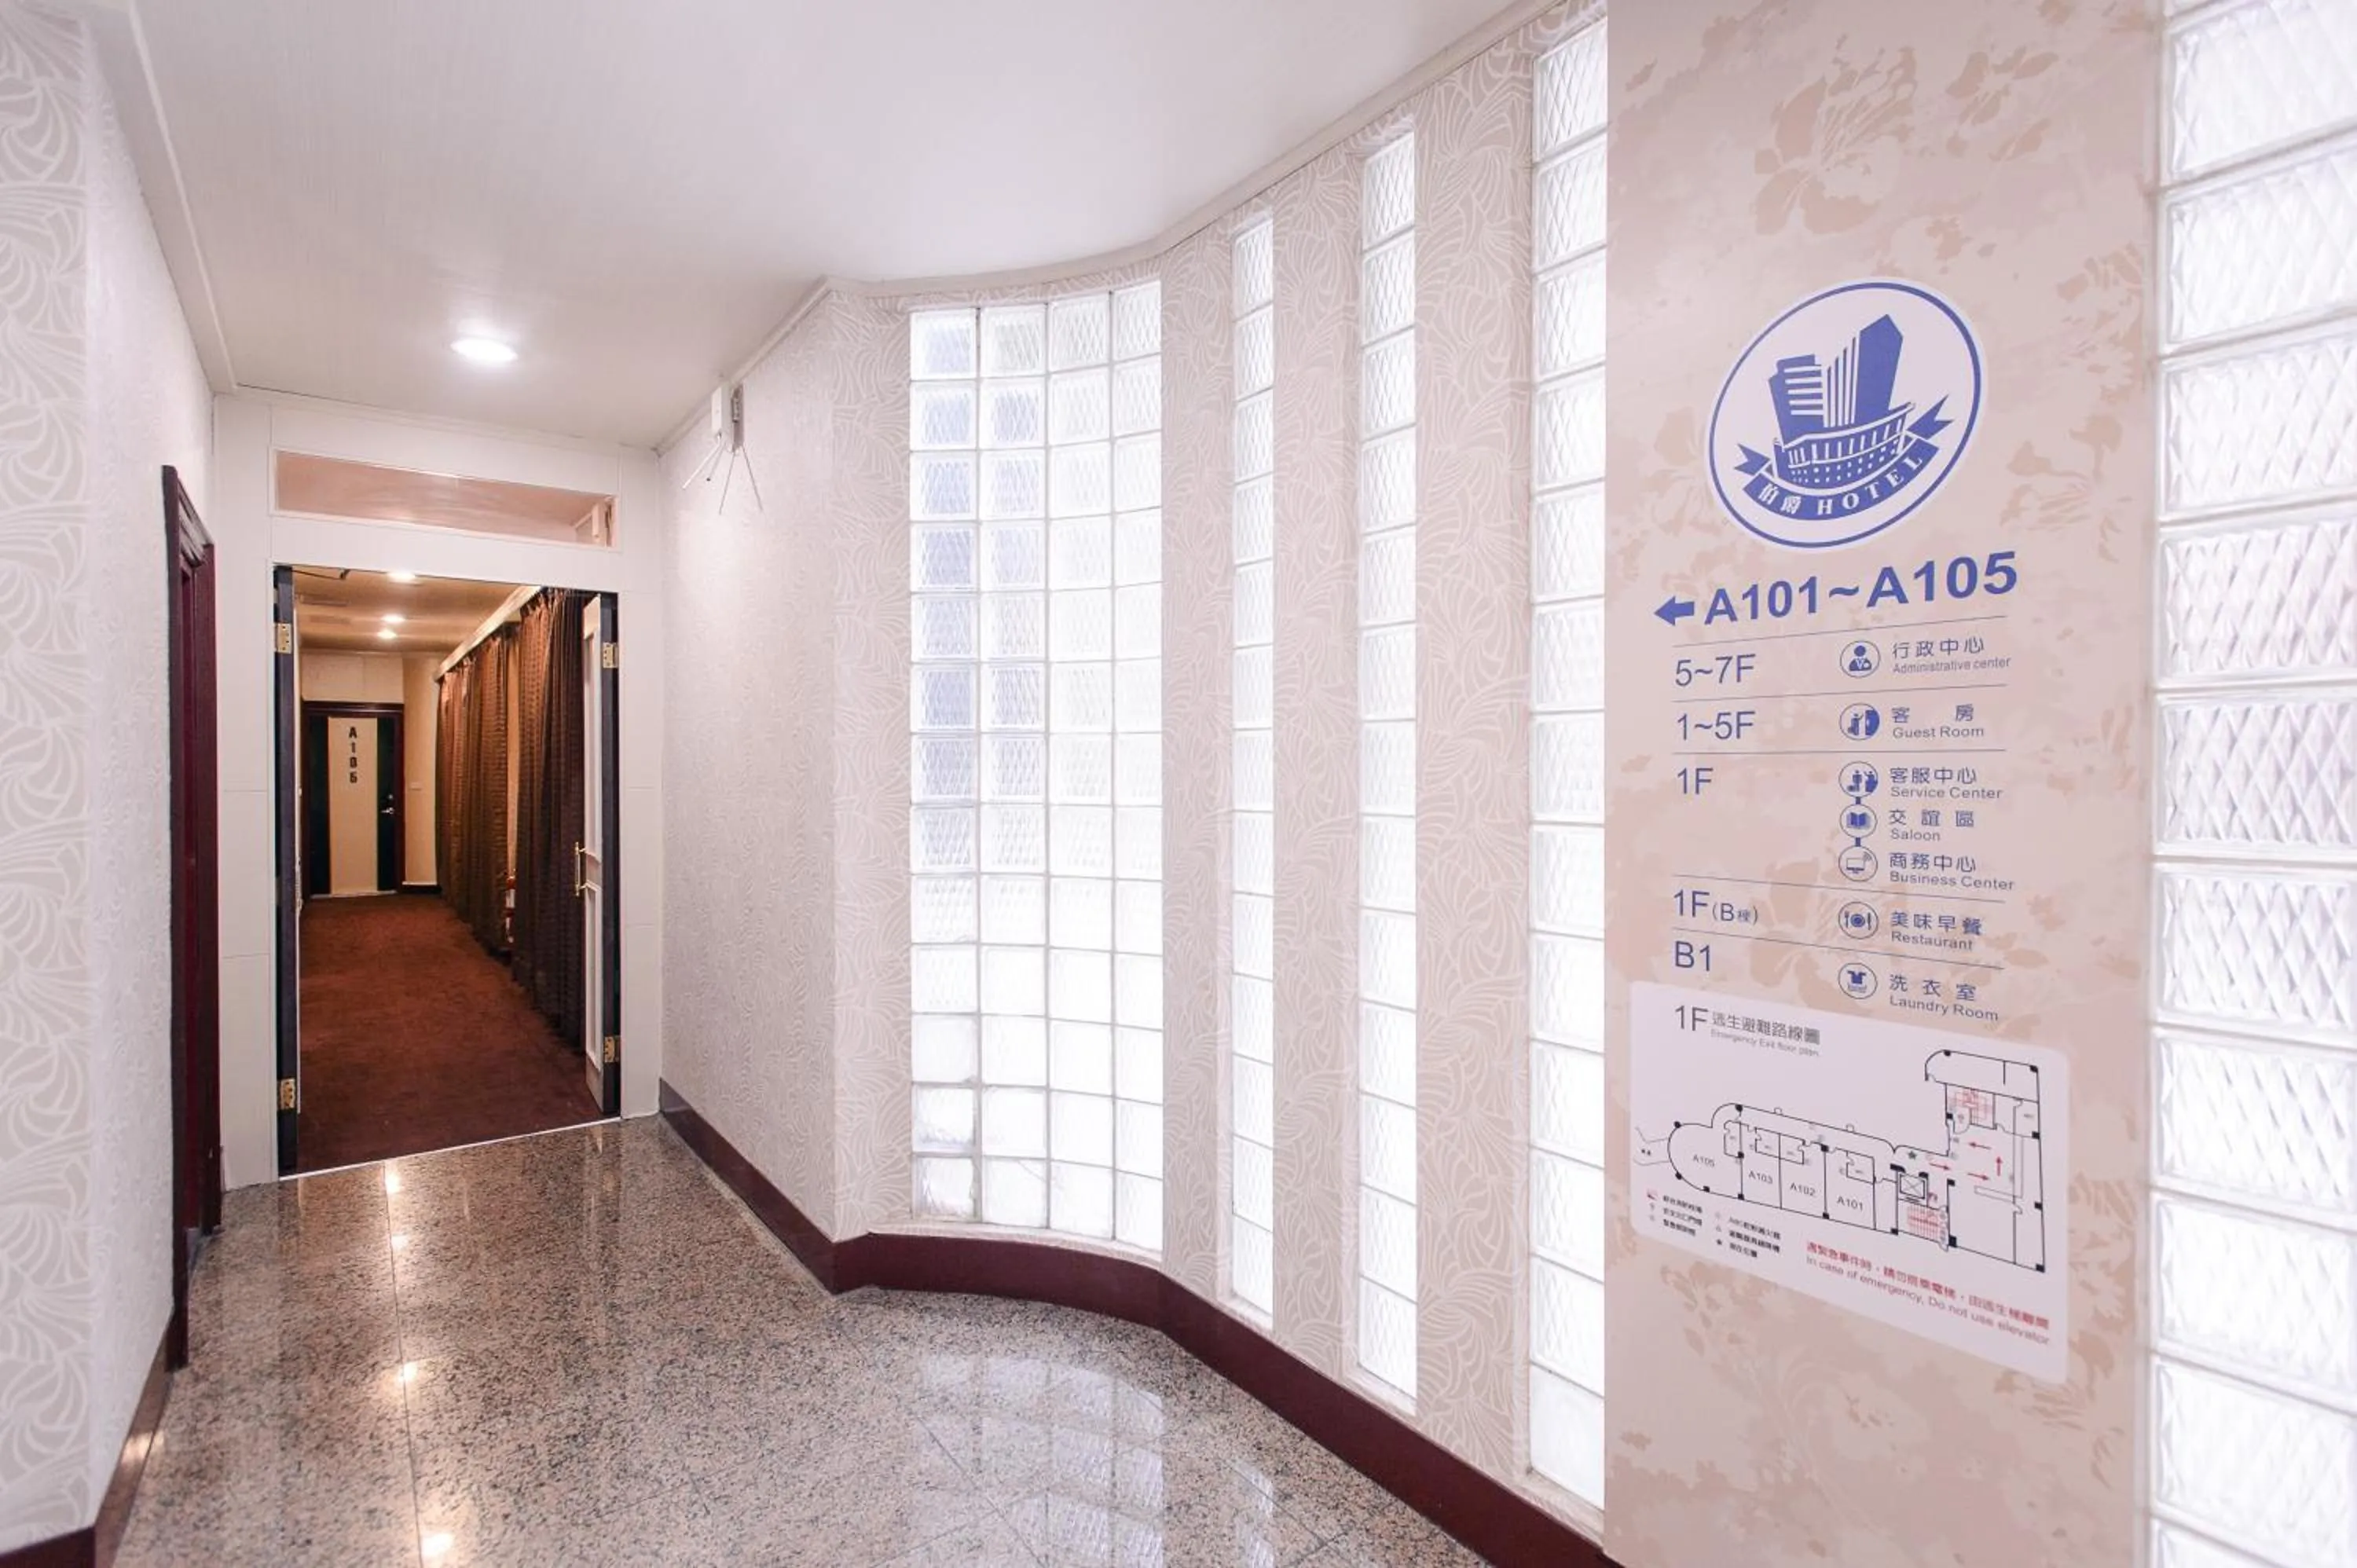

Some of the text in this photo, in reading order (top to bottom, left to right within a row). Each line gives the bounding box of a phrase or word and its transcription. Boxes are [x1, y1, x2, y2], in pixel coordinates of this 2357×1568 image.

[1817, 456, 1923, 515] HOTEL
[1704, 551, 2018, 625] A101~A105
[1892, 637, 1985, 658] 行政中心
[1675, 654, 1756, 687] 5~7F
[1892, 656, 2012, 675] Administrative center
[1677, 710, 1756, 741] 1~5F
[1892, 724, 1985, 740] Guest Room
[1677, 767, 1714, 796] 1F
[1890, 767, 1978, 785] 客服中心
[1890, 786, 2004, 800] Service Center
[1889, 809, 1974, 828] 交誼區
[1890, 828, 1941, 842] Saloon
[1889, 852, 1977, 873] 商務中心
[1890, 871, 2015, 892] Business Center
[1891, 911, 1983, 936] 美味早餐
[1891, 931, 1974, 951] Restaurant
[1675, 940, 1711, 972] B1
[1890, 975, 1978, 1002] 洗衣室
[1675, 1005, 1709, 1031] 1F
[1890, 995, 1999, 1022] Laundry Room
[1748, 1170, 1773, 1184] A103
[1790, 1182, 1816, 1197] A102
[1836, 1196, 1864, 1211] A101
